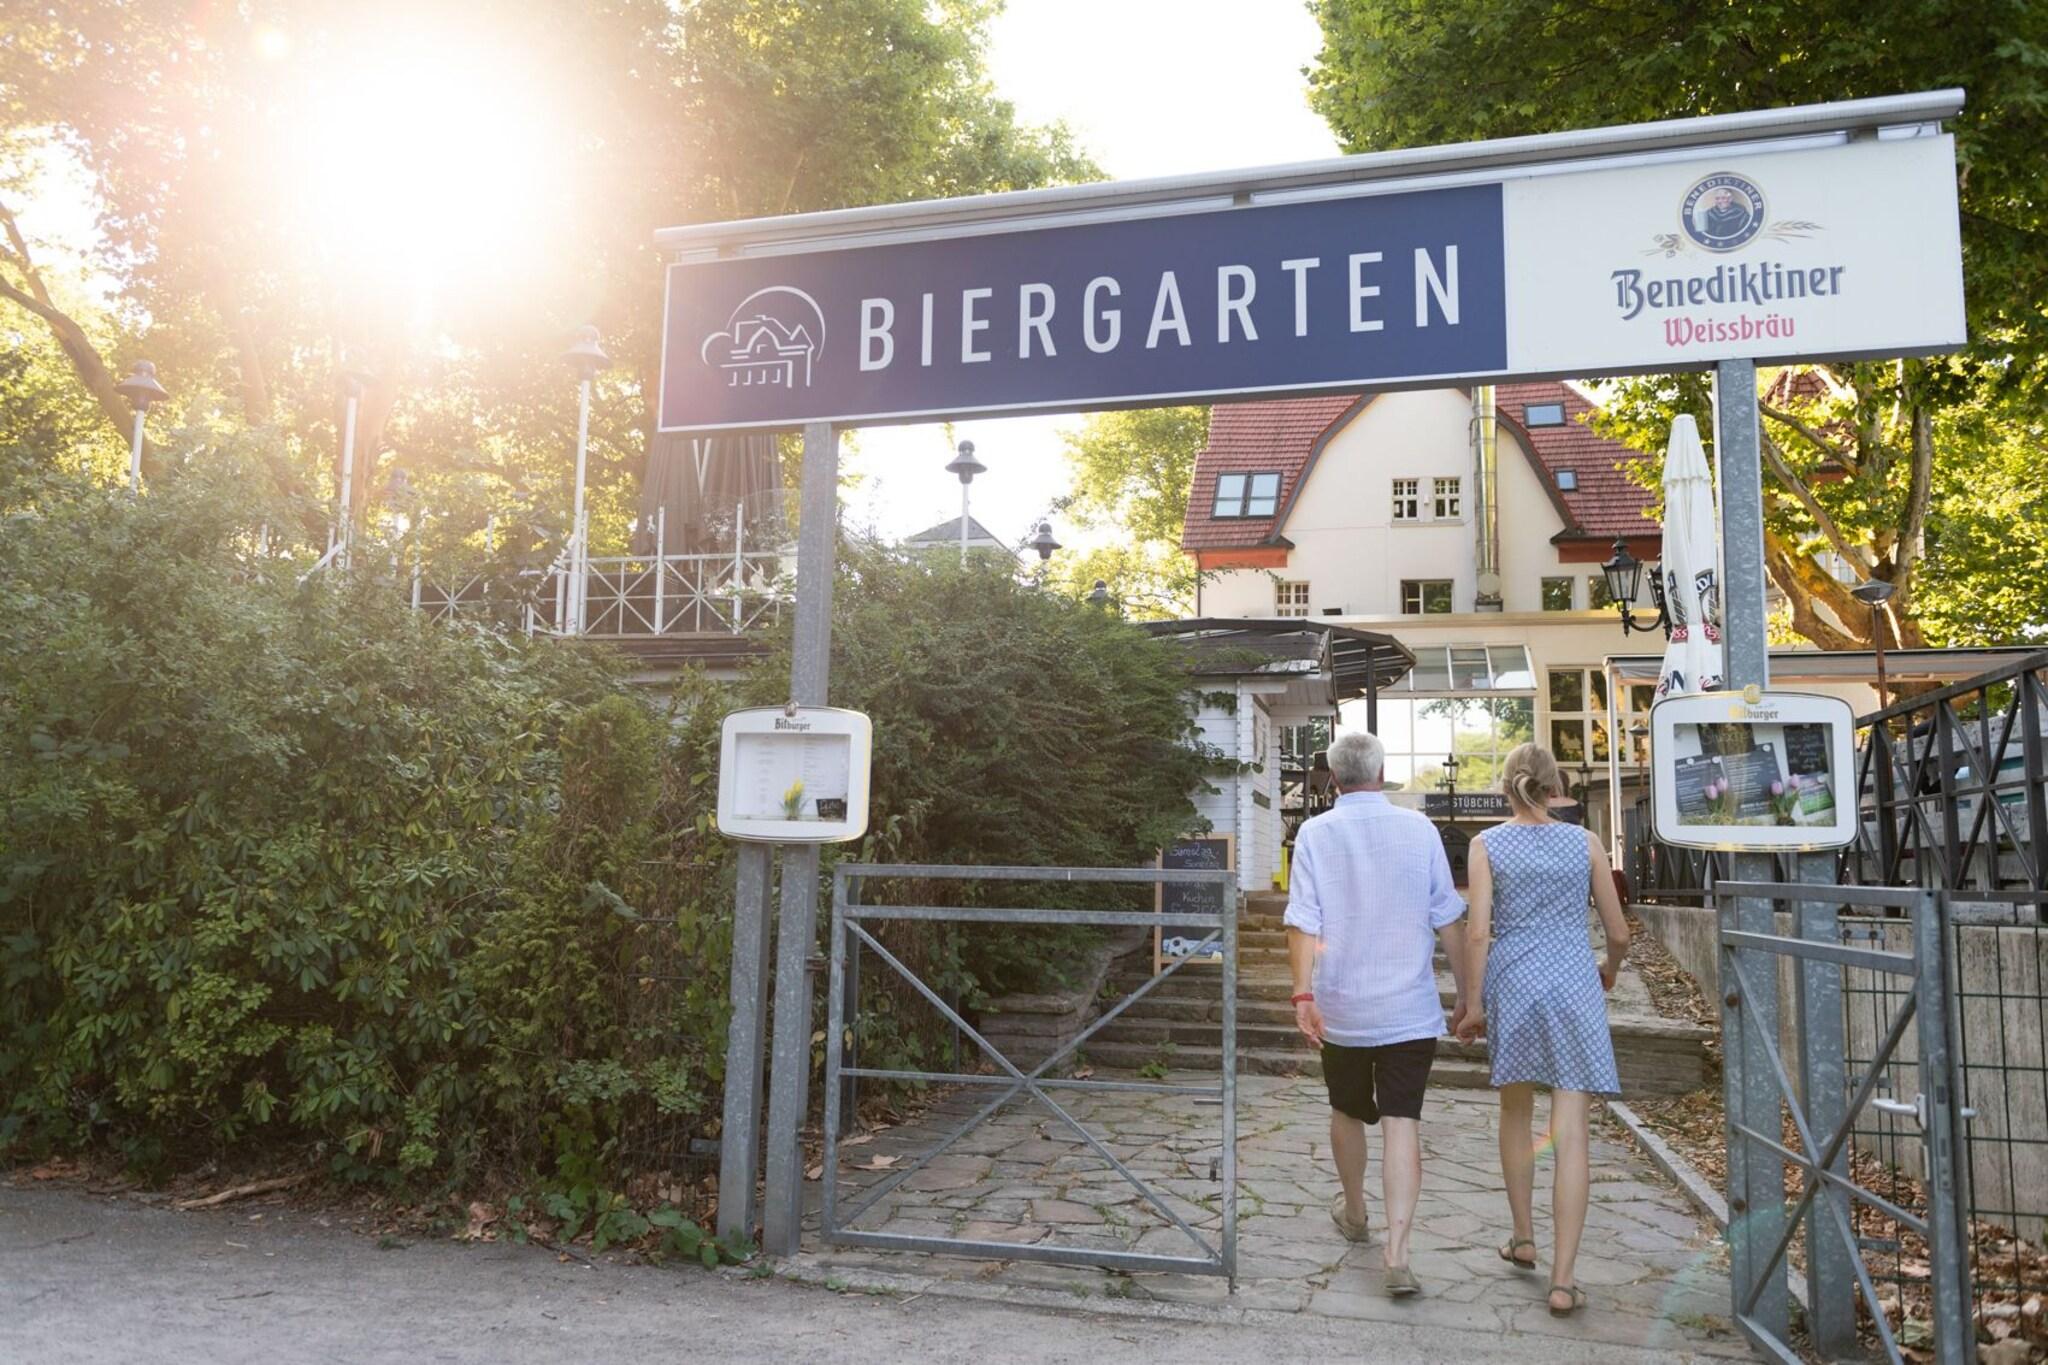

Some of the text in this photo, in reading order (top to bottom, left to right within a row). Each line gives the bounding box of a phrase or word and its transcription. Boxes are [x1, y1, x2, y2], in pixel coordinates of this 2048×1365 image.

[859, 244, 1461, 371] BIERGARTEN
[1610, 261, 1844, 321] Benediktiner
[1664, 313, 1795, 347] Weissbräu
[1452, 795, 1503, 809] STÜBCHEN
